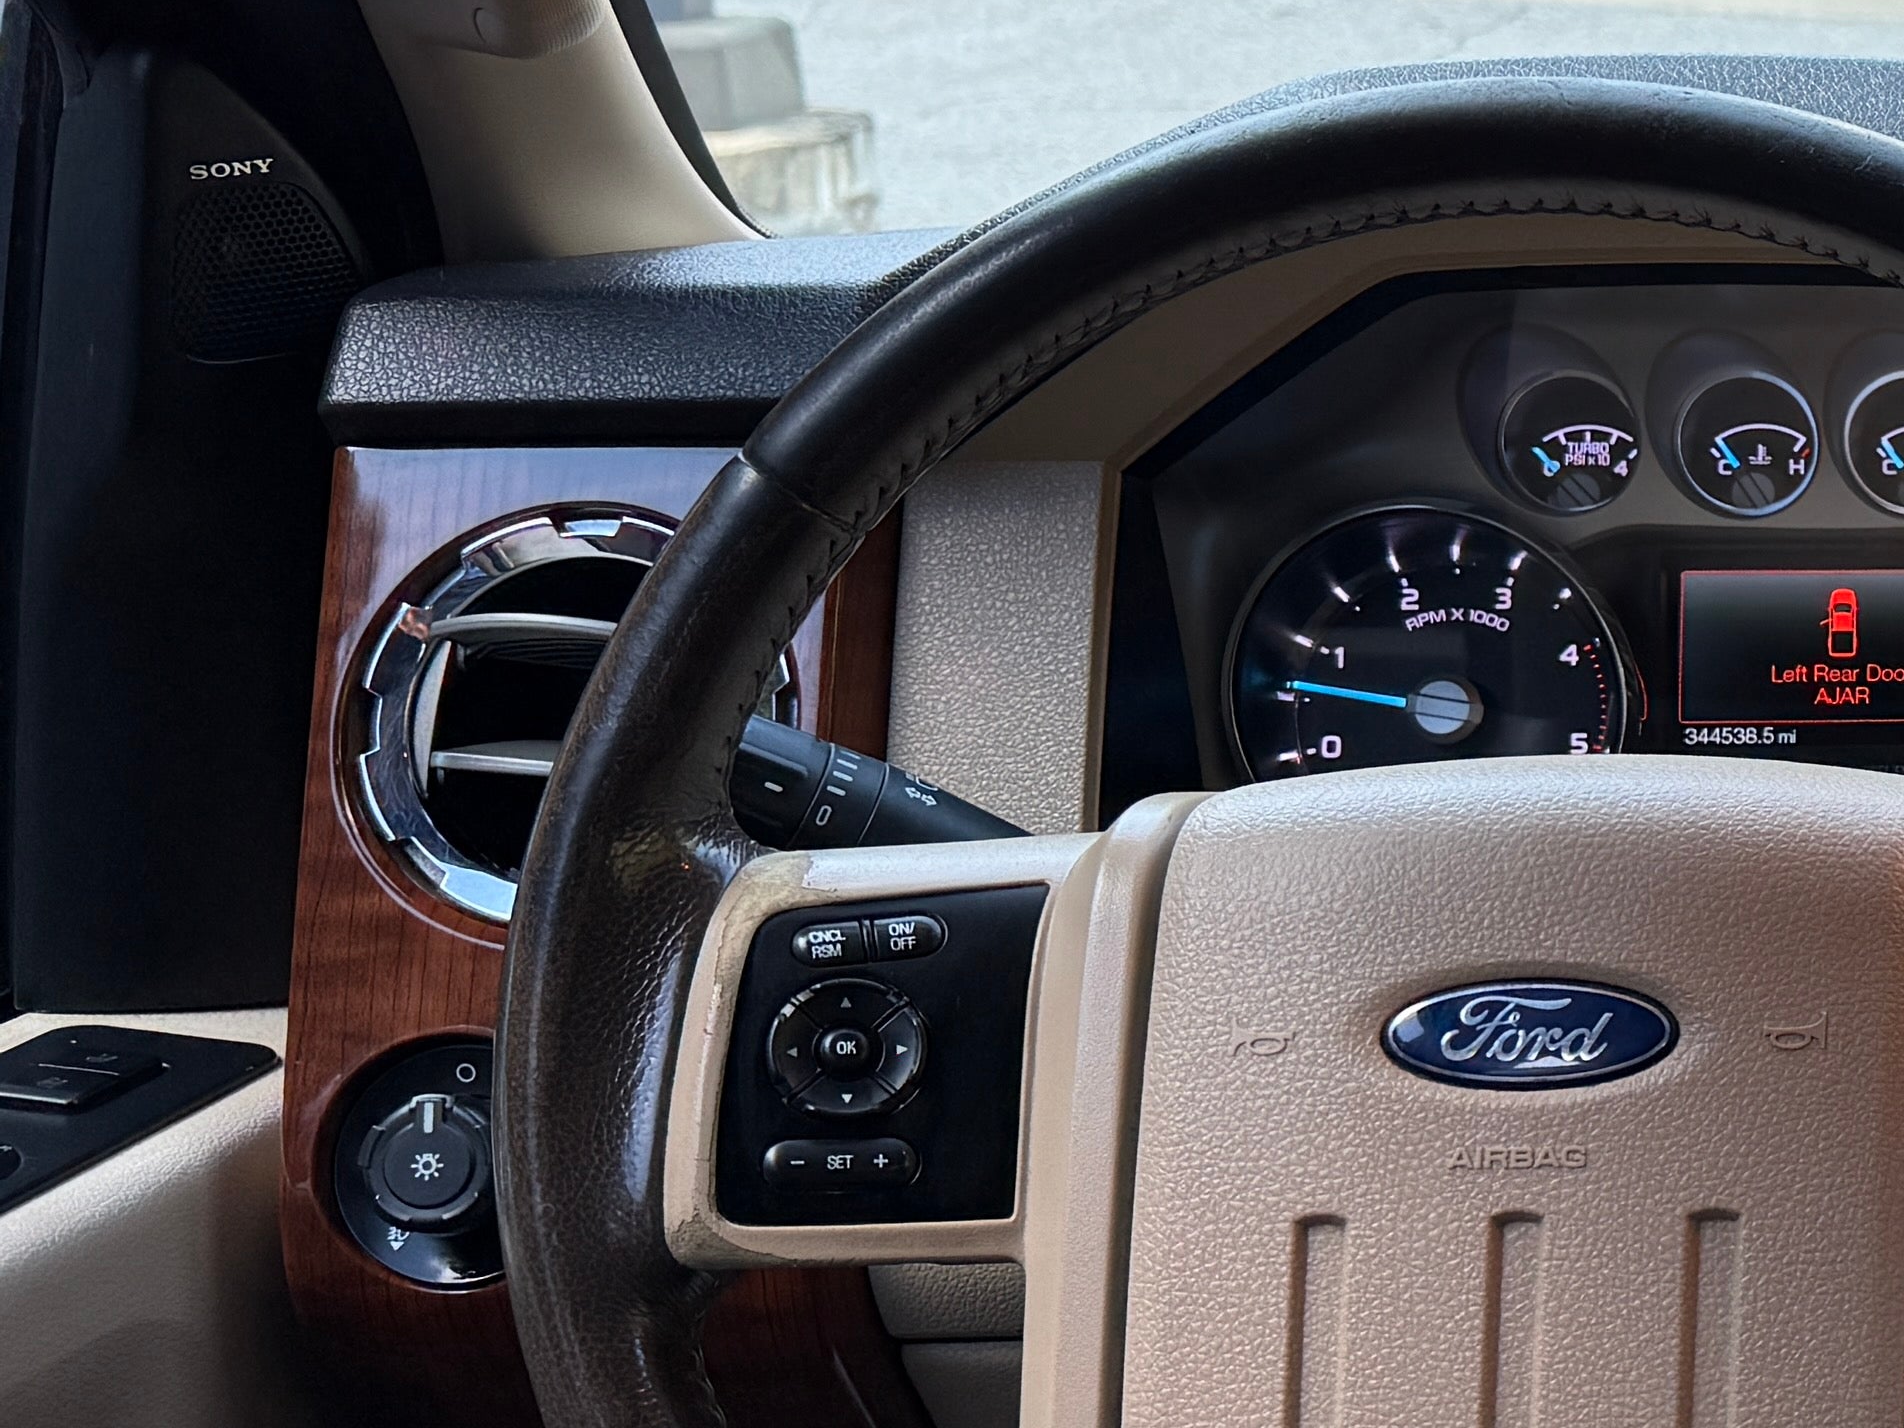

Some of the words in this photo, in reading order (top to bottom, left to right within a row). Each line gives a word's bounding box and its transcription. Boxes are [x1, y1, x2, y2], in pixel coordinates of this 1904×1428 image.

[189, 158, 273, 180] SONY
[1567, 442, 1610, 455] TURBO
[1565, 454, 1586, 467] PSI
[1598, 453, 1611, 467] 10
[1614, 460, 1628, 477] 4
[1718, 459, 1733, 475] C
[1789, 459, 1805, 475] H
[1882, 459, 1898, 475] C
[1401, 588, 1419, 611] 2
[1495, 587, 1512, 610] 3
[1405, 609, 1447, 632] RPM
[1451, 607, 1465, 622] X
[1468, 608, 1511, 632] 1000
[1333, 646, 1345, 669] 1
[1558, 644, 1580, 667] 4
[1771, 664, 1807, 683] Left
[1814, 664, 1860, 683] Rear
[1814, 686, 1870, 705] AJAR
[1570, 732, 1588, 755] 5
[1683, 727, 1774, 745] 344538.5
[1778, 728, 1797, 744] mi
[1321, 735, 1342, 759] 0
[808, 929, 847, 945] CNCL
[888, 921, 916, 936] ON/
[811, 943, 843, 960] RSM
[890, 936, 917, 951] OFF
[1440, 994, 1614, 1068] Ford
[836, 1040, 858, 1056] OK
[826, 1154, 854, 1170] SET
[1447, 1144, 1588, 1171] AIRBAG
